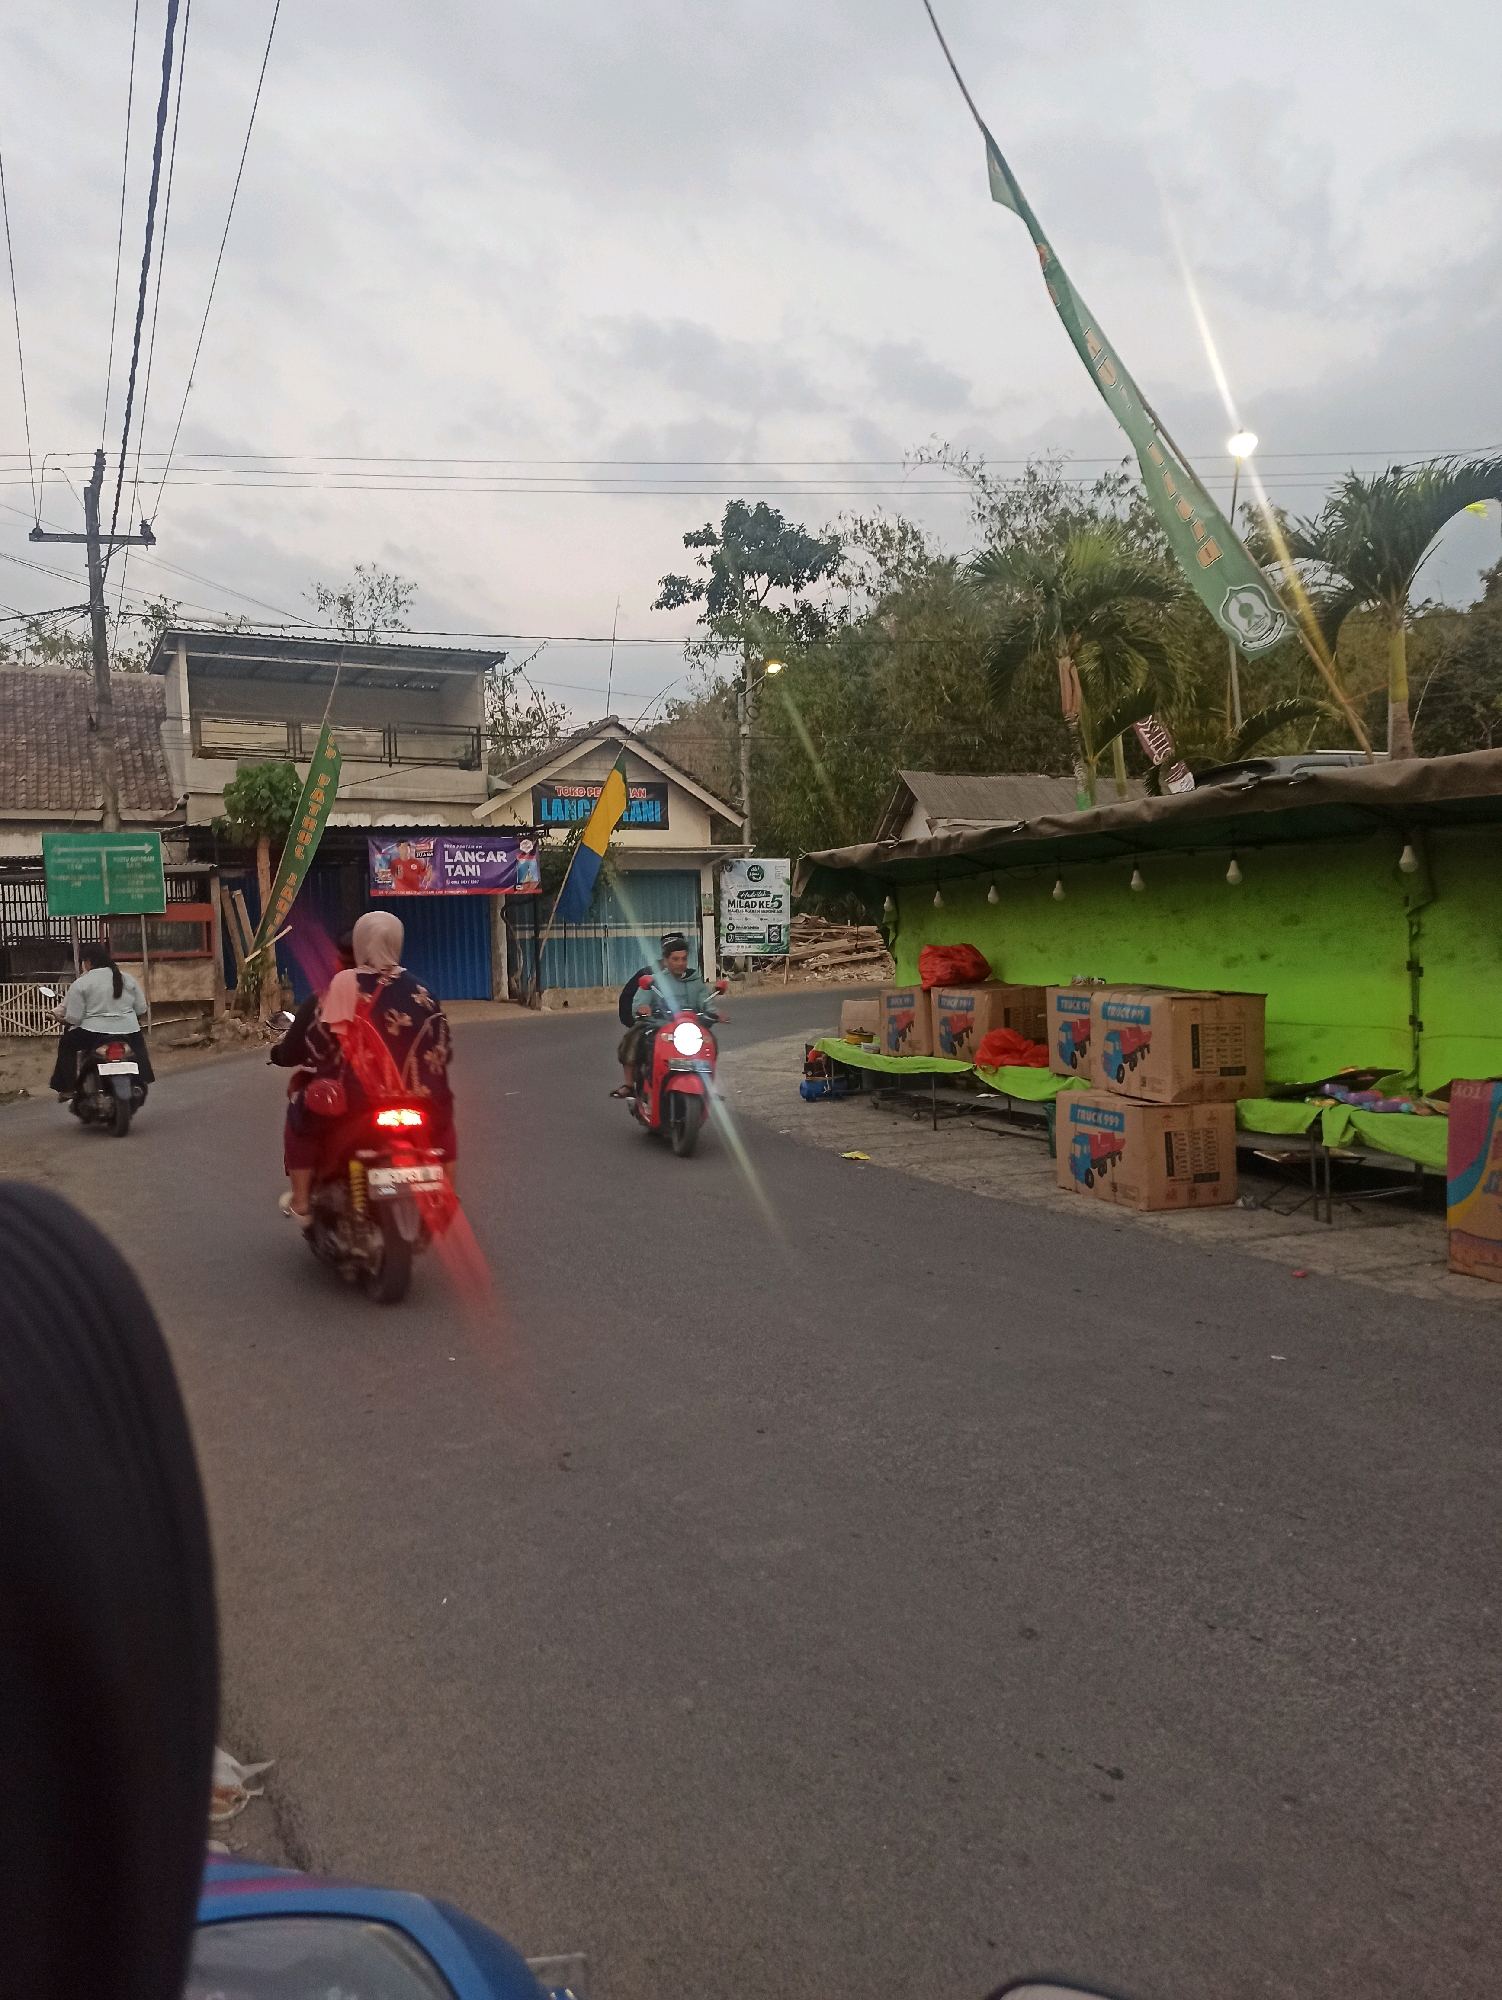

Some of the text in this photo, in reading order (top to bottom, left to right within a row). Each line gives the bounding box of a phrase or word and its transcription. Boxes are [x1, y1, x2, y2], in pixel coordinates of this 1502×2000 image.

[555, 786, 586, 797] TOKO
[444, 850, 507, 863] LANCAR
[444, 864, 481, 877] TANI
[727, 894, 783, 909] MILAD KE 5
[1060, 999, 1081, 1011] TRUCK
[1106, 1005, 1131, 1019] TRUCK
[1077, 1108, 1120, 1127] TRUCK 999
